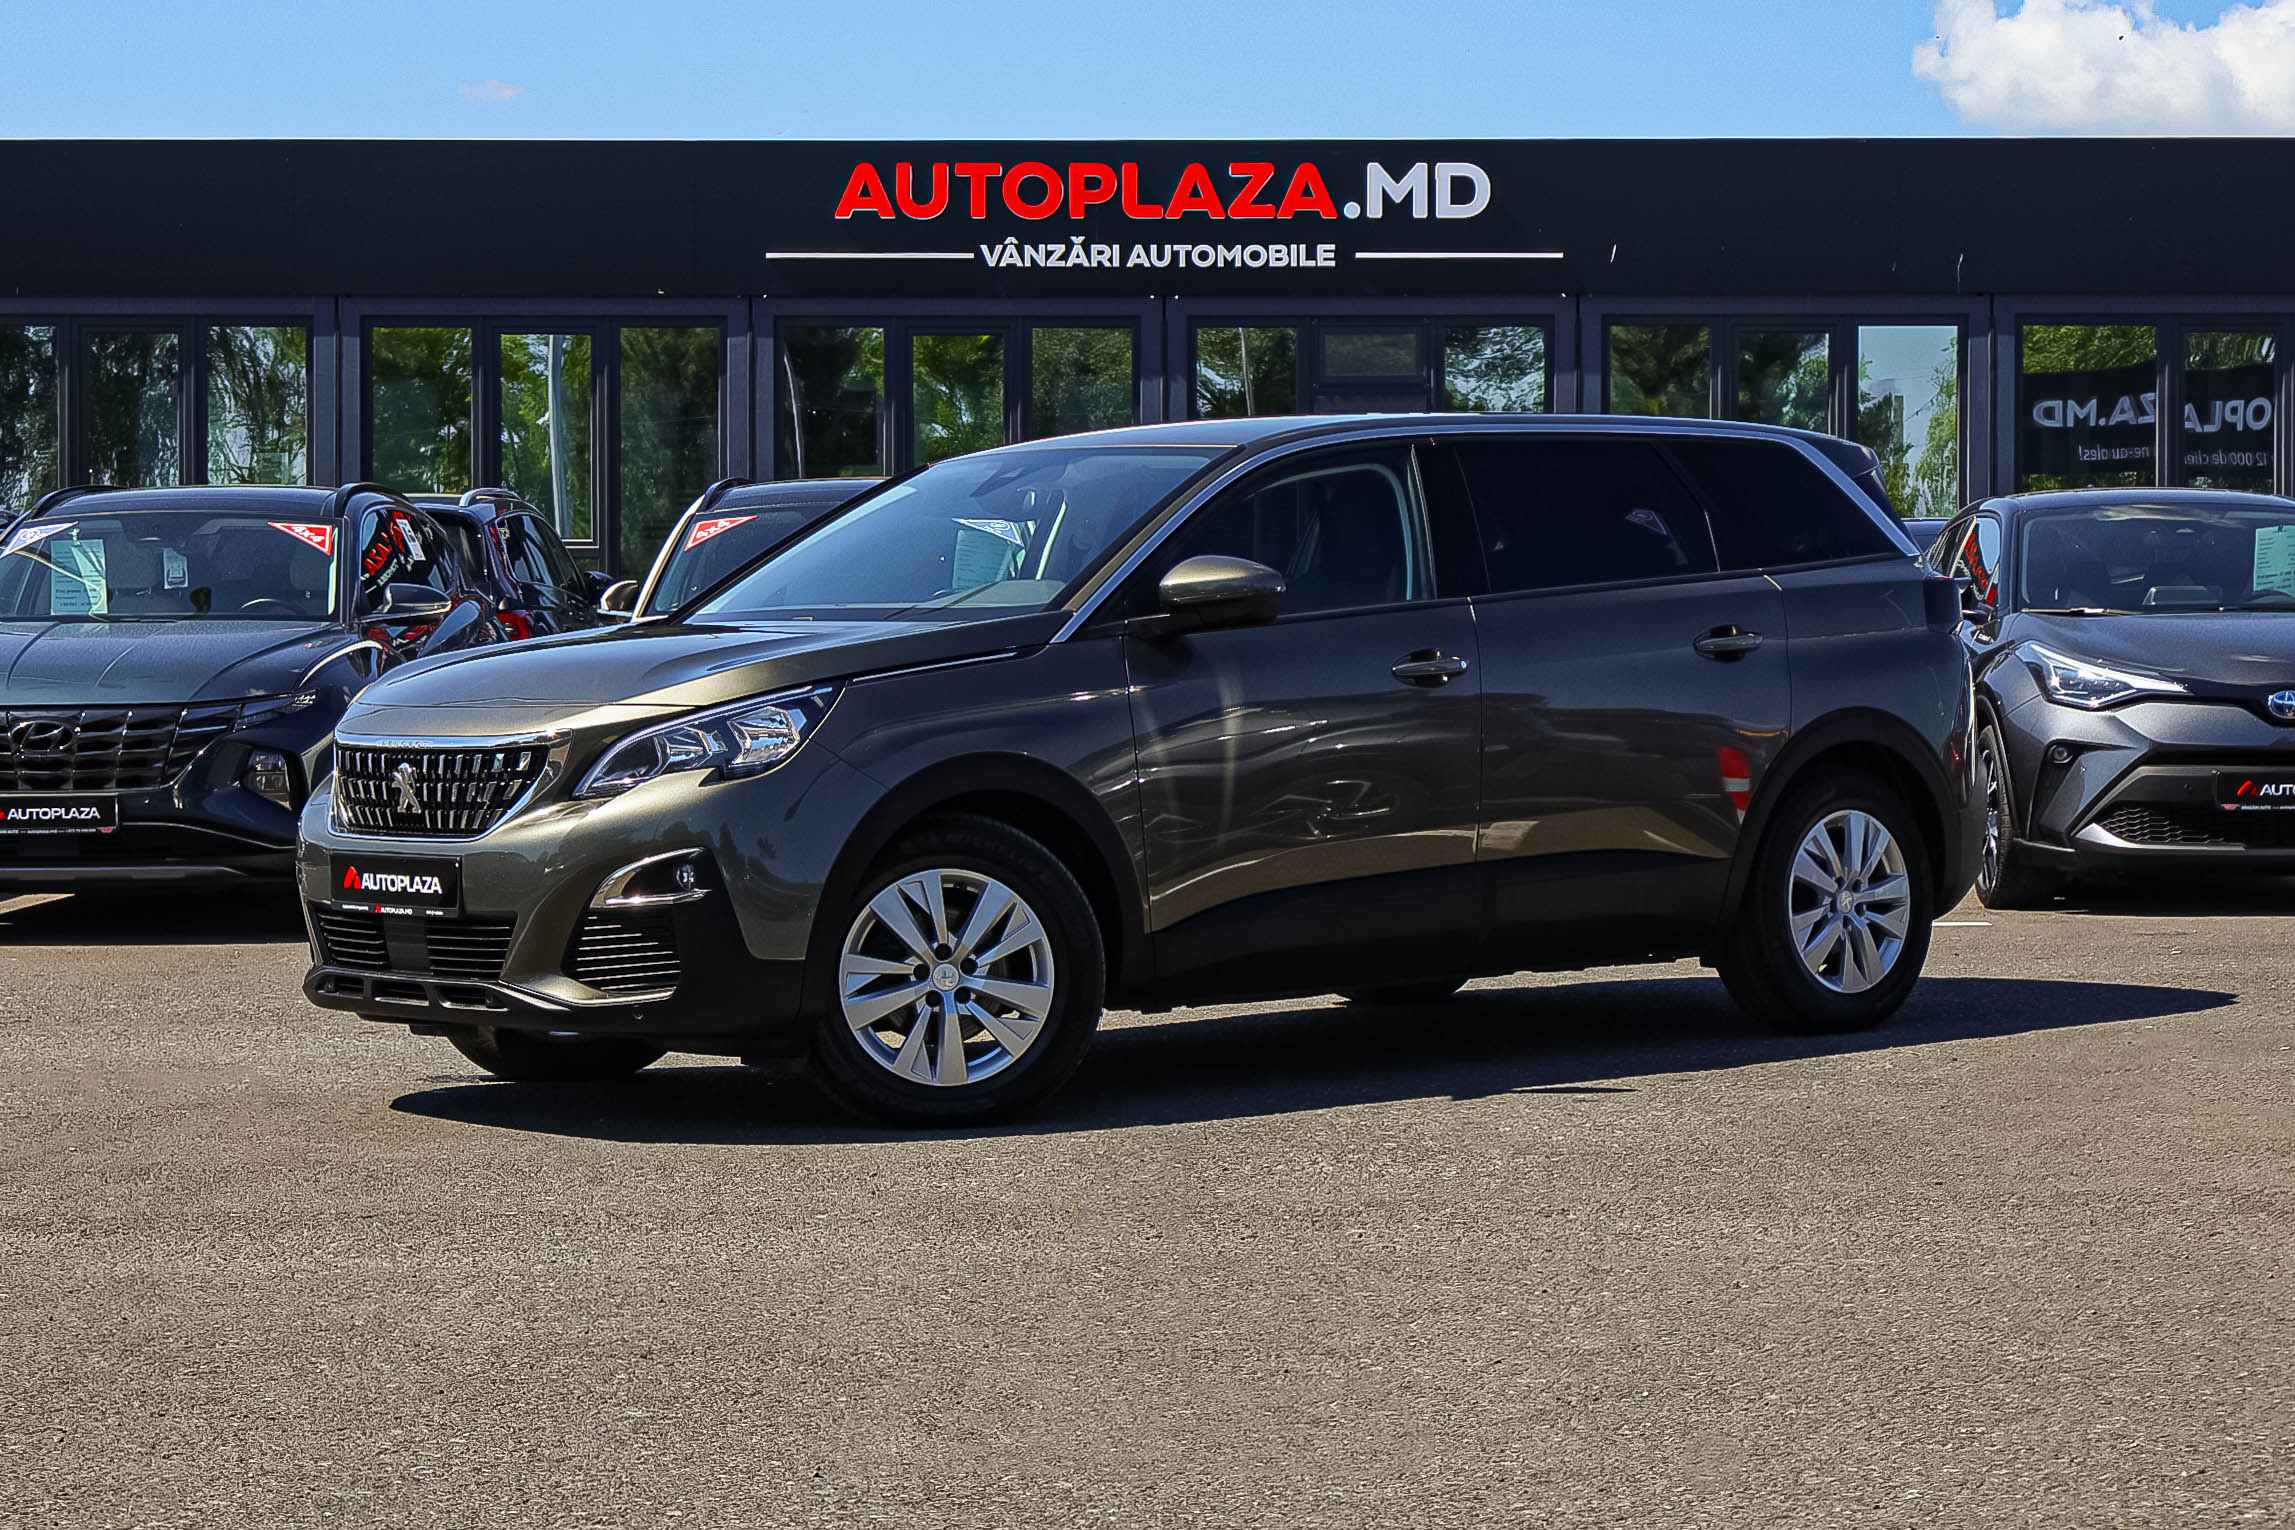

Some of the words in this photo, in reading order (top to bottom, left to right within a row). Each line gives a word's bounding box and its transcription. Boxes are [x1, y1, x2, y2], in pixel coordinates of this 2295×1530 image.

[834, 161, 1491, 220] AUTOPLAZA.MD
[980, 236, 1120, 267] VÂNZĂRI
[1127, 244, 1336, 268] AUTOMOBILE
[2259, 783, 2295, 796] AUT
[7, 807, 100, 820] AUTOPLAZA
[361, 873, 442, 894] AUTOPLAZA
